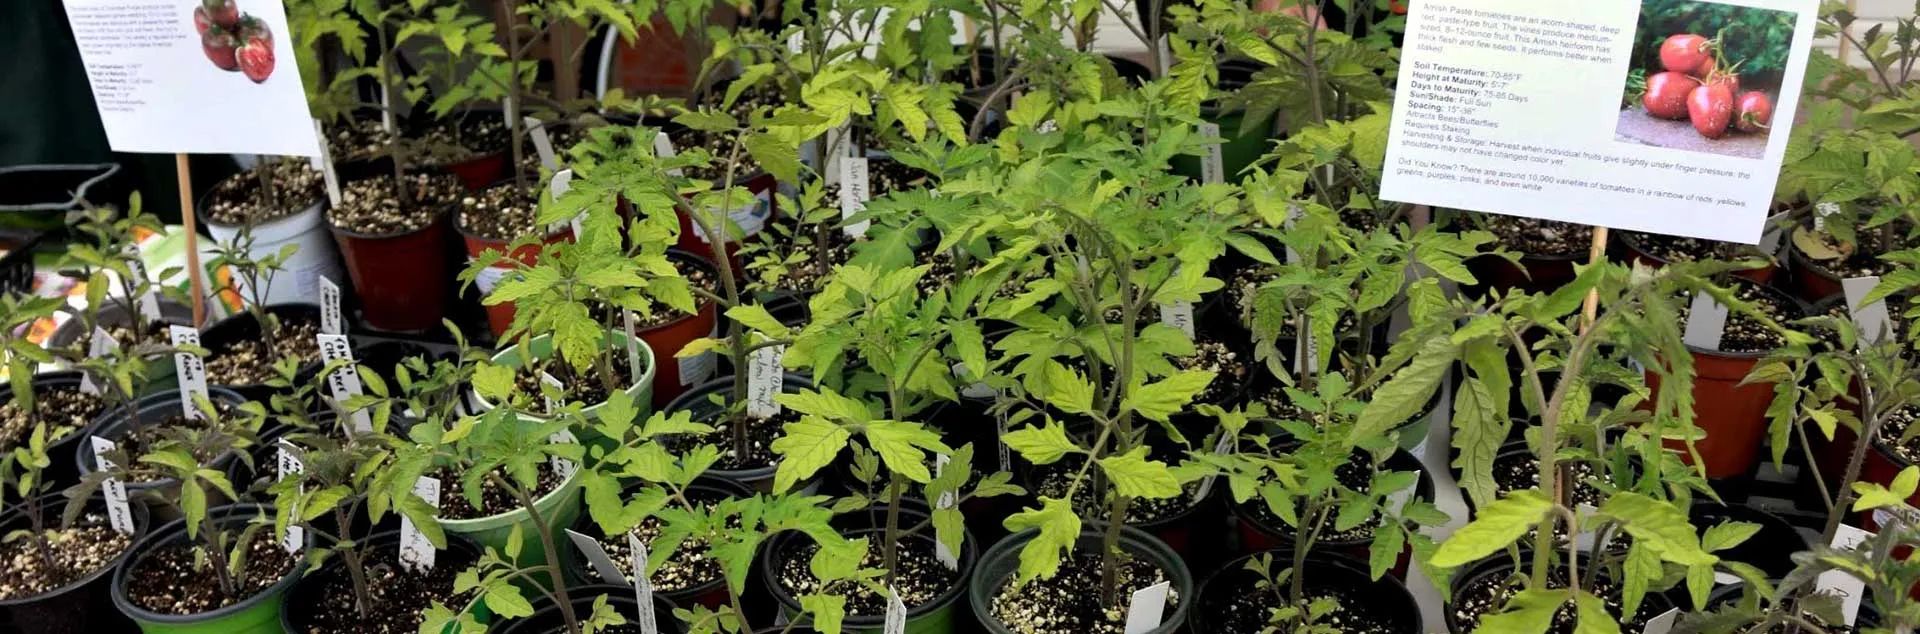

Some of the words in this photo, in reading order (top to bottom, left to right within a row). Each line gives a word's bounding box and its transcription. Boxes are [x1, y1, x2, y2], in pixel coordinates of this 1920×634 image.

[1423, 3, 1448, 13] Amish
[1449, 6, 1472, 16] Paste
[1473, 9, 1511, 20] tomatoes
[1599, 24, 1620, 35] deep
[1437, 15, 1480, 28] paste-type
[1501, 23, 1517, 31] The
[1519, 25, 1540, 34] vines
[1542, 28, 1574, 40] produce
[1577, 32, 1612, 43] medium-
[1417, 33, 1436, 42] thick
[1438, 35, 1457, 44] flesh
[1458, 38, 1474, 46] and
[1476, 40, 1491, 48] few
[1521, 45, 1526, 53] It
[1527, 46, 1563, 59] performs
[1564, 51, 1588, 60] better
[1589, 54, 1612, 63] when
[1513, 34, 1530, 43] This
[1531, 36, 1557, 46] Amish
[1559, 40, 1594, 51] heirloom
[1595, 44, 1612, 53] has
[1411, 71, 1439, 83] Height
[1451, 76, 1488, 89] Maturity:
[1413, 61, 1430, 70] Soil
[1431, 63, 1487, 79] Temperature:
[1409, 90, 1456, 103] Sun/Shade:
[1459, 97, 1473, 105] Full
[1475, 99, 1491, 107] Sun
[1410, 81, 1431, 92] Days
[1433, 83, 1442, 91] to
[1443, 85, 1481, 98] Maturity:
[1507, 93, 1528, 104] Days
[1405, 110, 1435, 120] Attracts
[1403, 119, 1439, 132] Requires
[1441, 124, 1472, 136] Staking
[1400, 138, 1439, 150] shoulders
[1440, 144, 1457, 154] may
[1459, 145, 1472, 154] not
[1473, 147, 1492, 156] have
[1494, 150, 1528, 162] changed
[1529, 154, 1549, 163] color
[1402, 129, 1444, 142] Harvesting
[1445, 134, 1452, 142] &
[1488, 139, 1519, 150] Harvest
[1521, 143, 1542, 153] when
[1545, 146, 1580, 157] individual
[1582, 151, 1602, 160] fruits
[1602, 153, 1619, 164] give
[1621, 156, 1648, 167] slightly
[1650, 159, 1673, 169] under
[1674, 162, 1696, 173] finger
[1737, 170, 1751, 178] the
[1397, 157, 1411, 166] Did
[1413, 159, 1429, 168] You
[1430, 161, 1457, 171] Know?
[1459, 165, 1482, 174] There
[1498, 170, 1525, 180] around
[1556, 177, 1587, 187] varieties
[1590, 181, 1597, 189] of
[1599, 182, 1635, 193] tomatoes
[1653, 189, 1683, 199] rainbow
[1484, 177, 1499, 186] and
